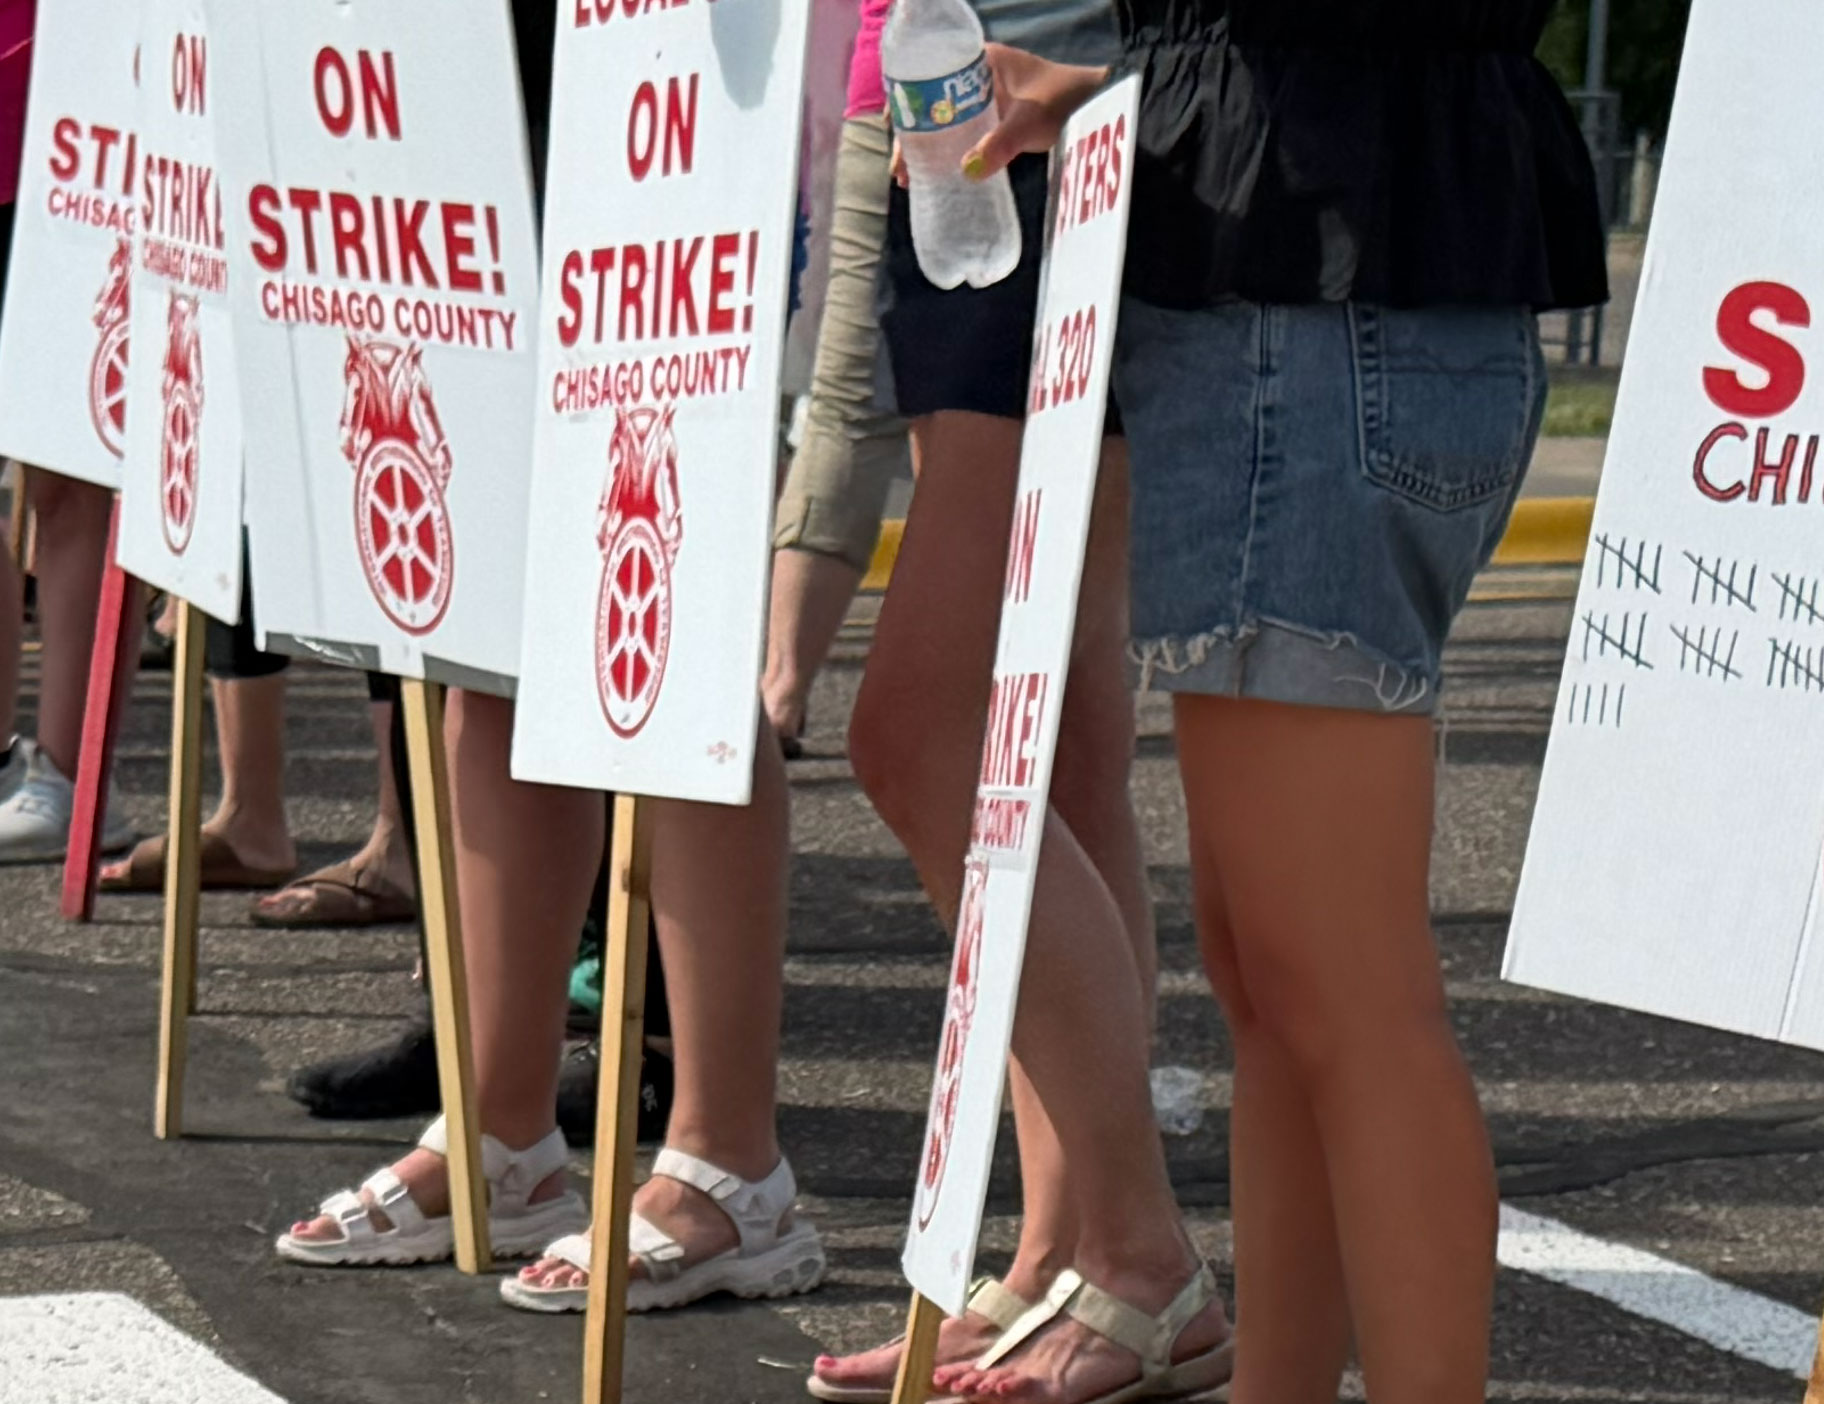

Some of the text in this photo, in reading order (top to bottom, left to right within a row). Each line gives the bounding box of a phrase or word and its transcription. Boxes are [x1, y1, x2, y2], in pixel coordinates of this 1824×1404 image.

[172, 33, 207, 116] ON
[314, 46, 401, 141] ON
[626, 73, 700, 182] ON
[248, 183, 507, 295] STRIKE!
[557, 230, 760, 347] STRIKE!
[262, 280, 517, 350] CHISAGO COUNTY
[1052, 303, 1096, 409] 320
[553, 344, 751, 414] CHISAGO COUNTY
